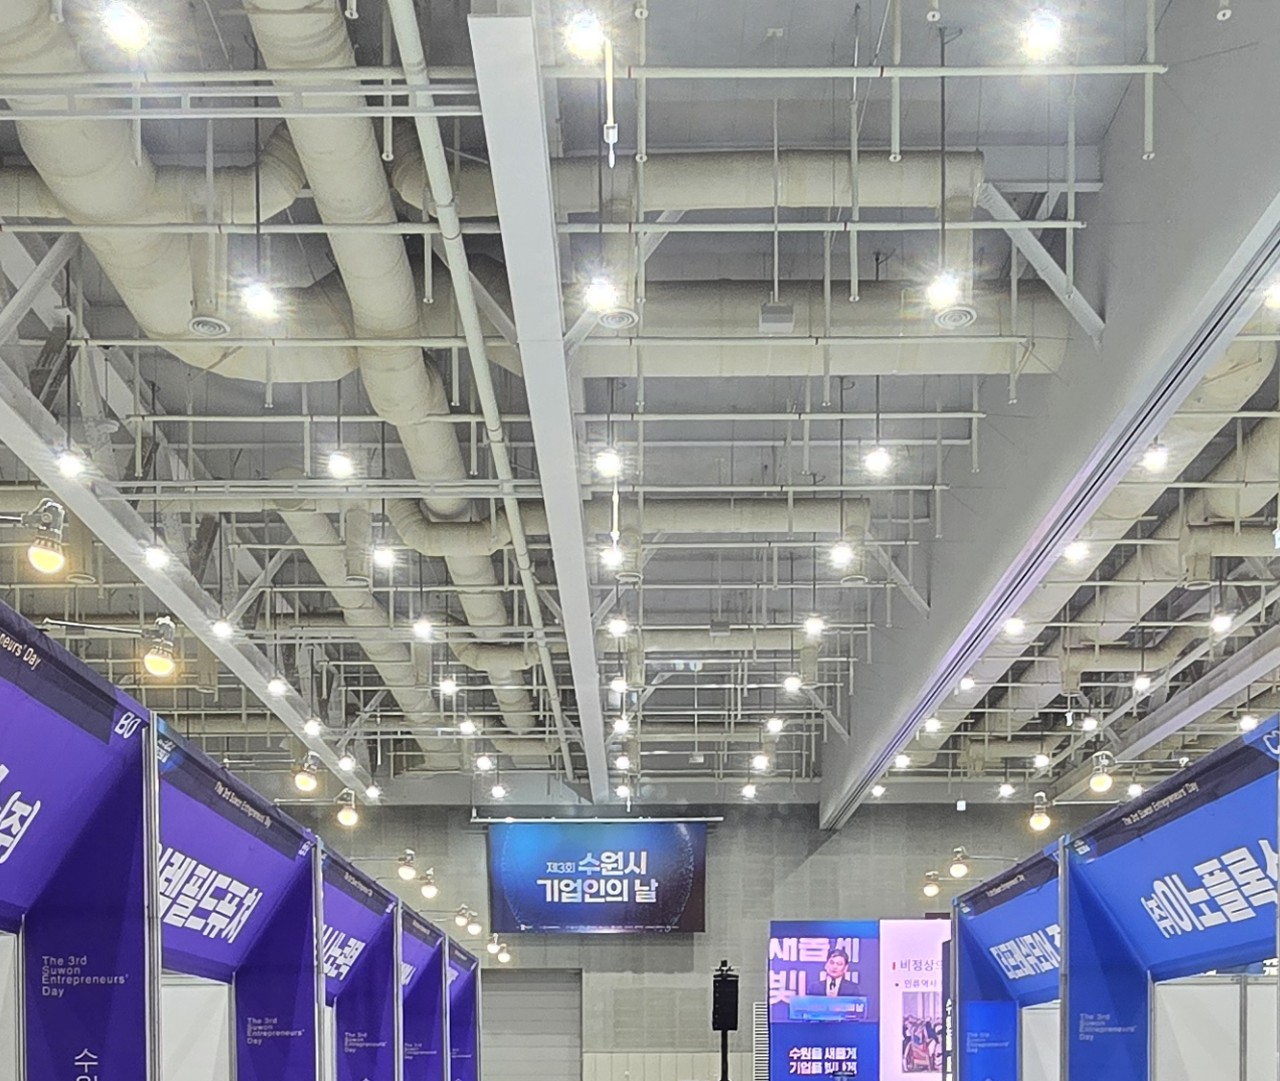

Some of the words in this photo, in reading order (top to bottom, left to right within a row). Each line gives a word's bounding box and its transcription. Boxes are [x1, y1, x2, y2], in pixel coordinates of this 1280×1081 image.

[23, 646, 42, 671] Day
[578, 850, 647, 875] 수원시
[537, 879, 629, 903] 기업인의
[635, 879, 658, 903] 날
[42, 955, 64, 966] The
[67, 955, 88, 966] 3rd
[42, 966, 81, 975] Suwon
[42, 986, 64, 998] Day
[789, 1047, 822, 1060] 수원을
[789, 1062, 822, 1075] 기업을
